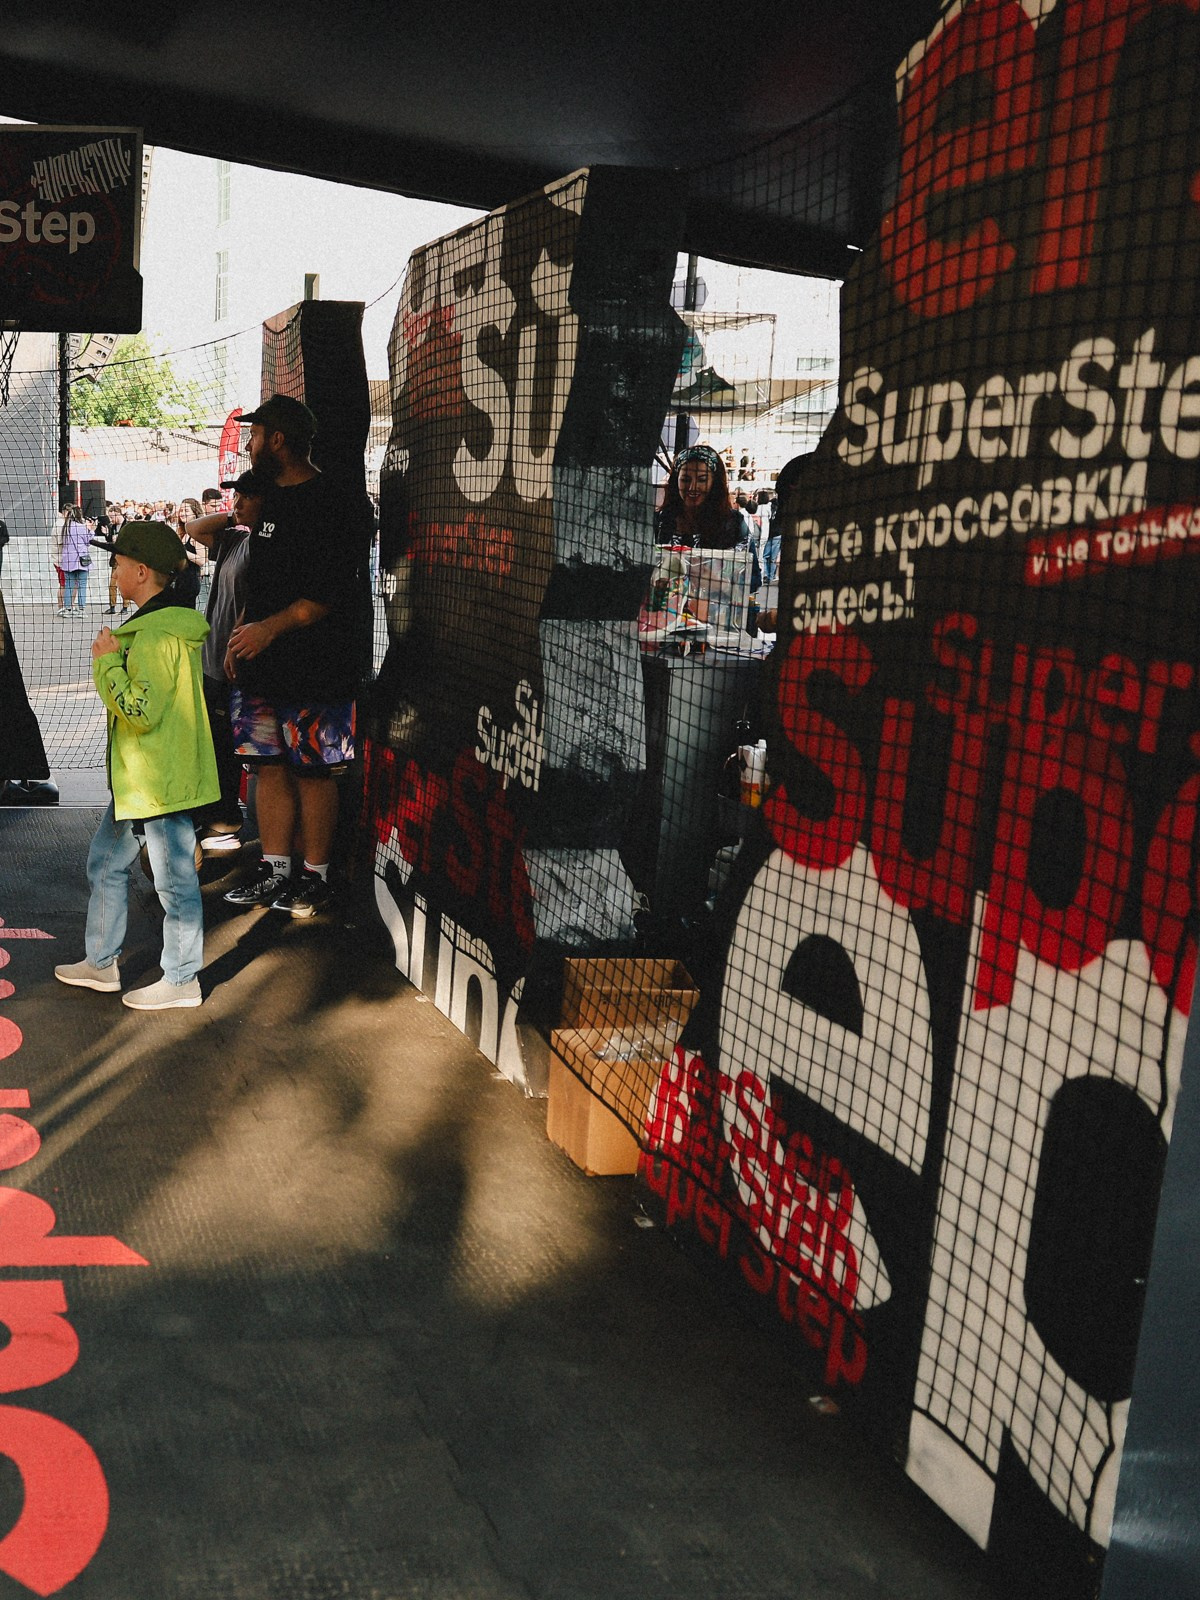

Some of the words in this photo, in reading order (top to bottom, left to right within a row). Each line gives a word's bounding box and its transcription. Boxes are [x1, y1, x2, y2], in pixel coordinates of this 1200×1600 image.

[262, 521, 275, 533] YO
[795, 518, 862, 573] Все
[874, 461, 1148, 572] кроссовки
